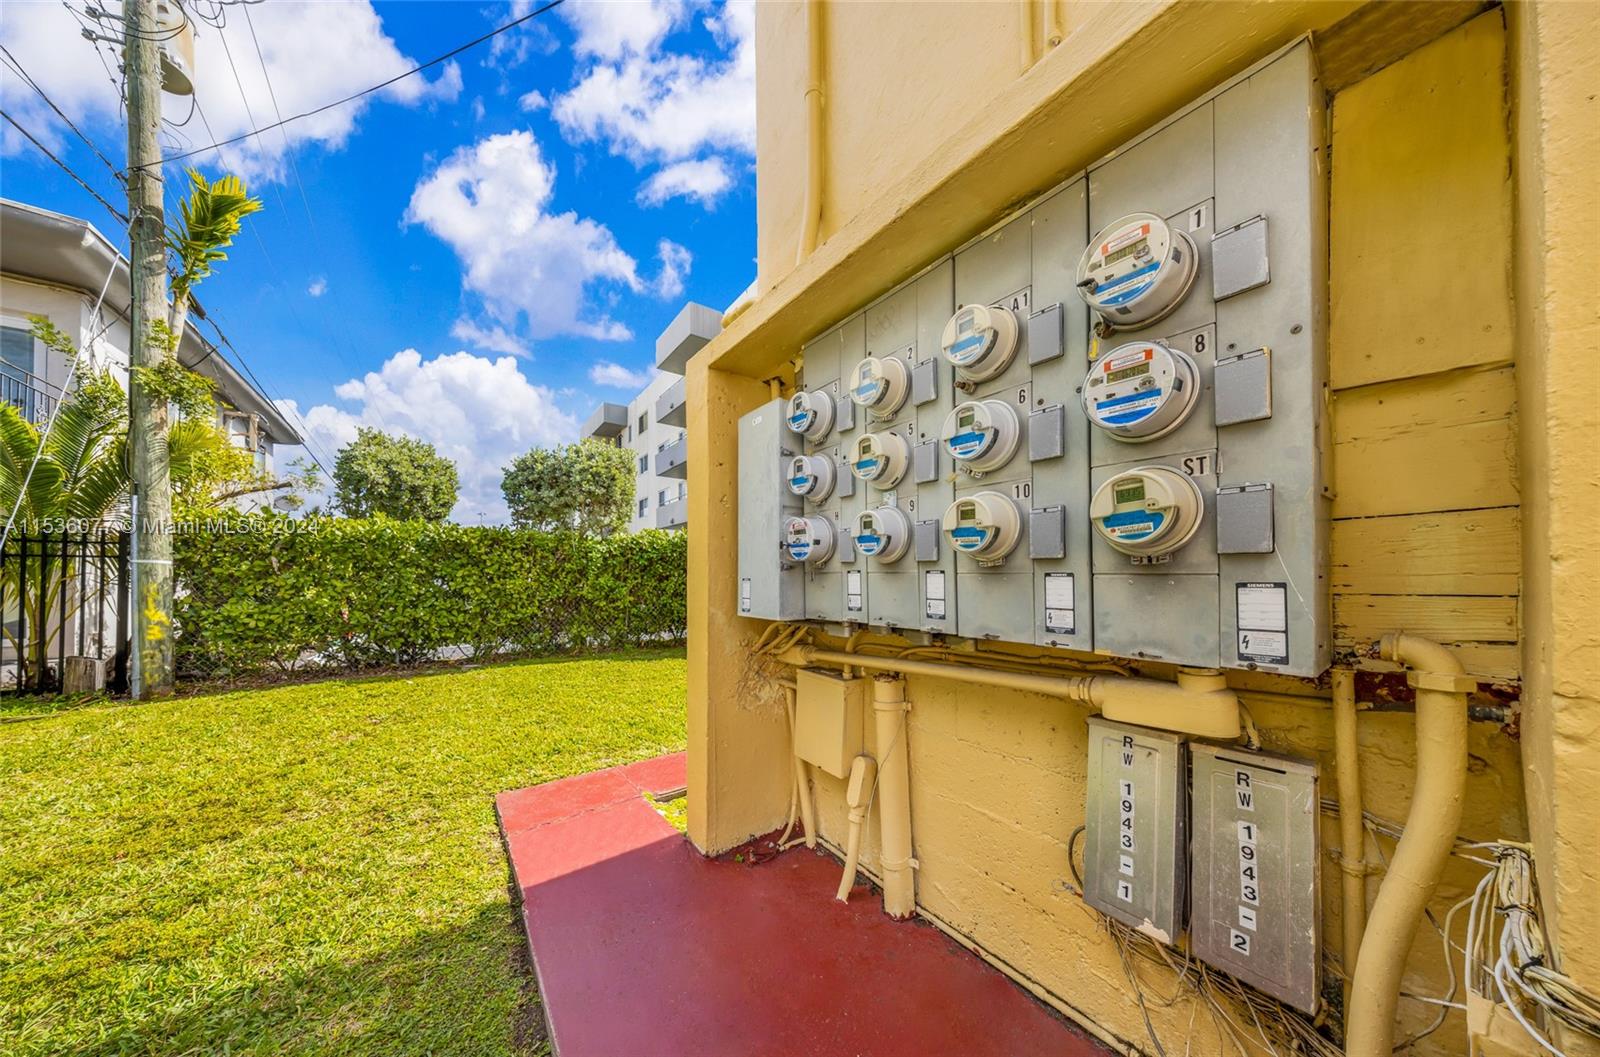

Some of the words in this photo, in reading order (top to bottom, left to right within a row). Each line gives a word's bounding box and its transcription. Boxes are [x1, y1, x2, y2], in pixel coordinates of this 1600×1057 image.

[1194, 208, 1202, 228] 1
[1195, 333, 1206, 353] 8
[907, 347, 913, 360] 2
[1018, 389, 1026, 404] 6
[908, 423, 914, 436] 5
[1183, 455, 1207, 476] ST
[1015, 483, 1030, 499] 10
[909, 499, 915, 512] 9
